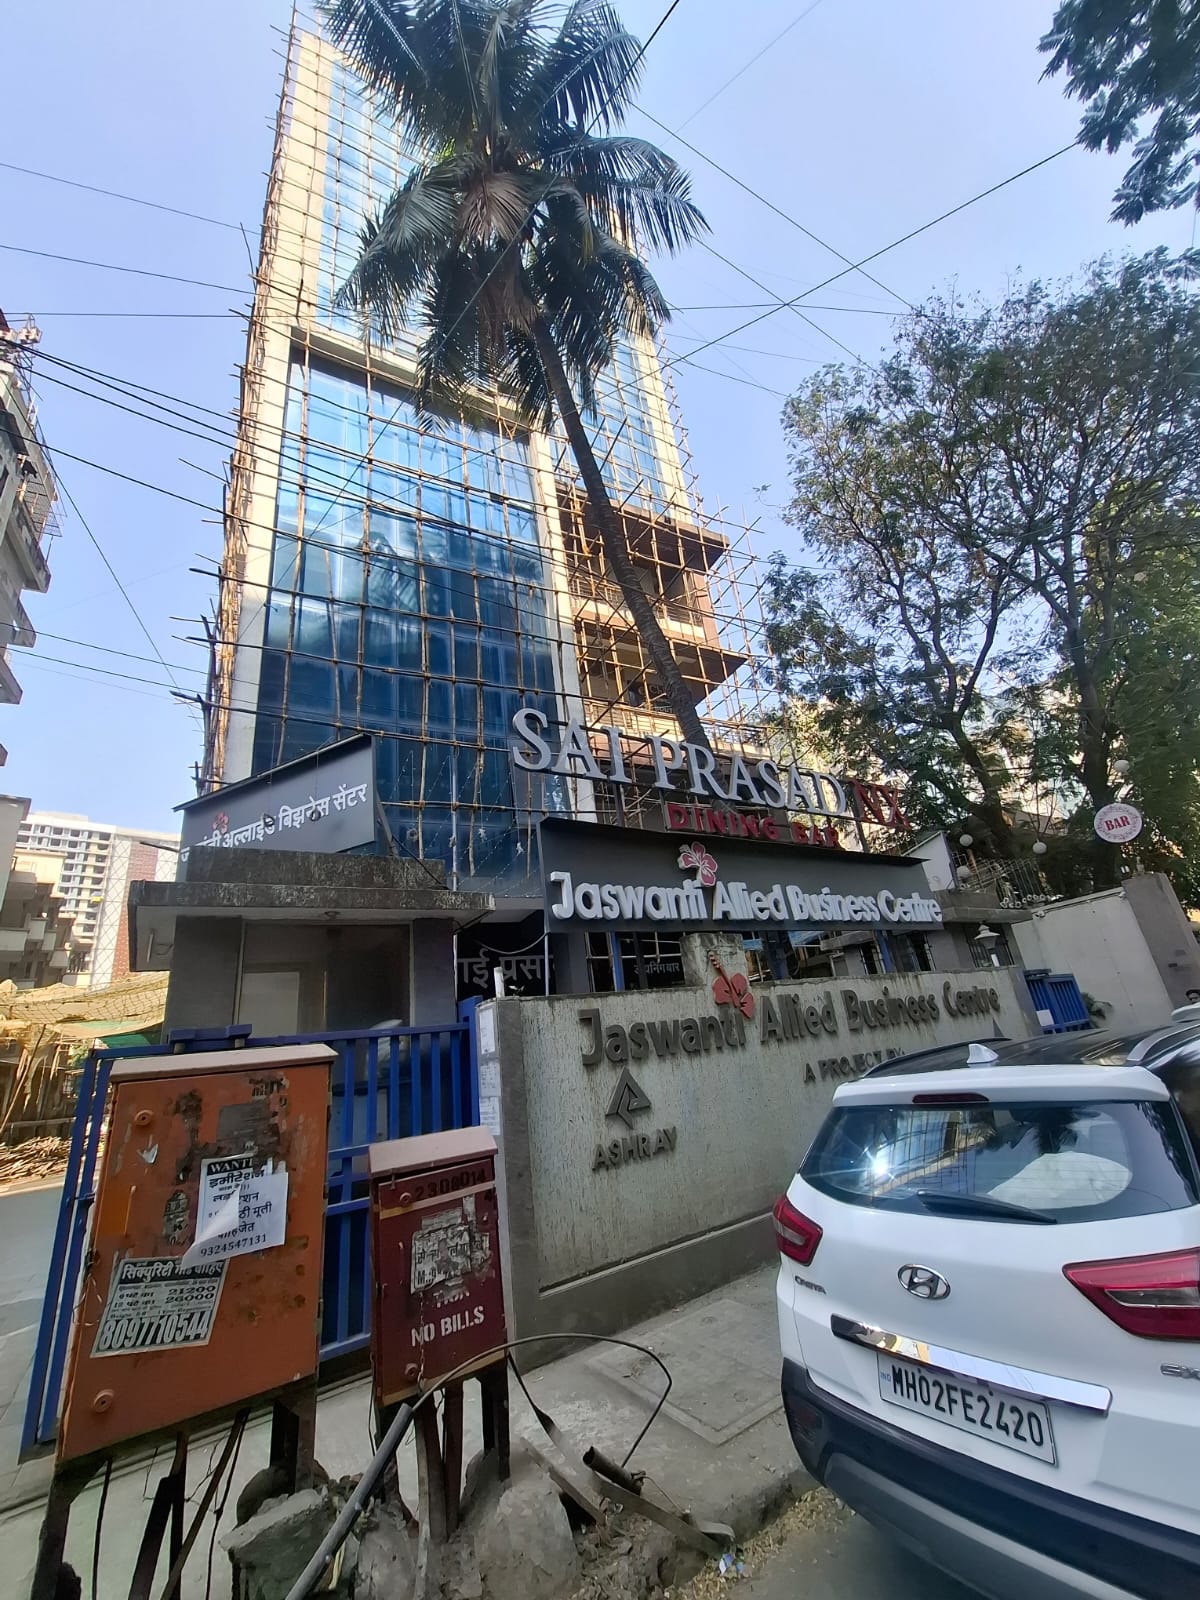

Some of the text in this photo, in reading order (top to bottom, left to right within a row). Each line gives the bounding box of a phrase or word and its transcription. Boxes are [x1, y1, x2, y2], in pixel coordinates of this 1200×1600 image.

[512, 707, 913, 831] SAI PRASAD NX
[665, 802, 839, 848] DINING BAR
[1104, 815, 1131, 831] BAR
[551, 871, 943, 923] Jaswanti Allied Business Centre
[578, 980, 1000, 1066] Jaswanti Allied Business Centre
[804, 1062, 816, 1084] A
[818, 1050, 882, 1081] PROJECT
[592, 1126, 678, 1172] ASHRAY
[201, 1234, 267, 1257] 9324547131
[99, 1310, 211, 1351] 8097710544
[411, 1305, 486, 1347] NO BILLS
[890, 1364, 1045, 1448] MH02FE2420
